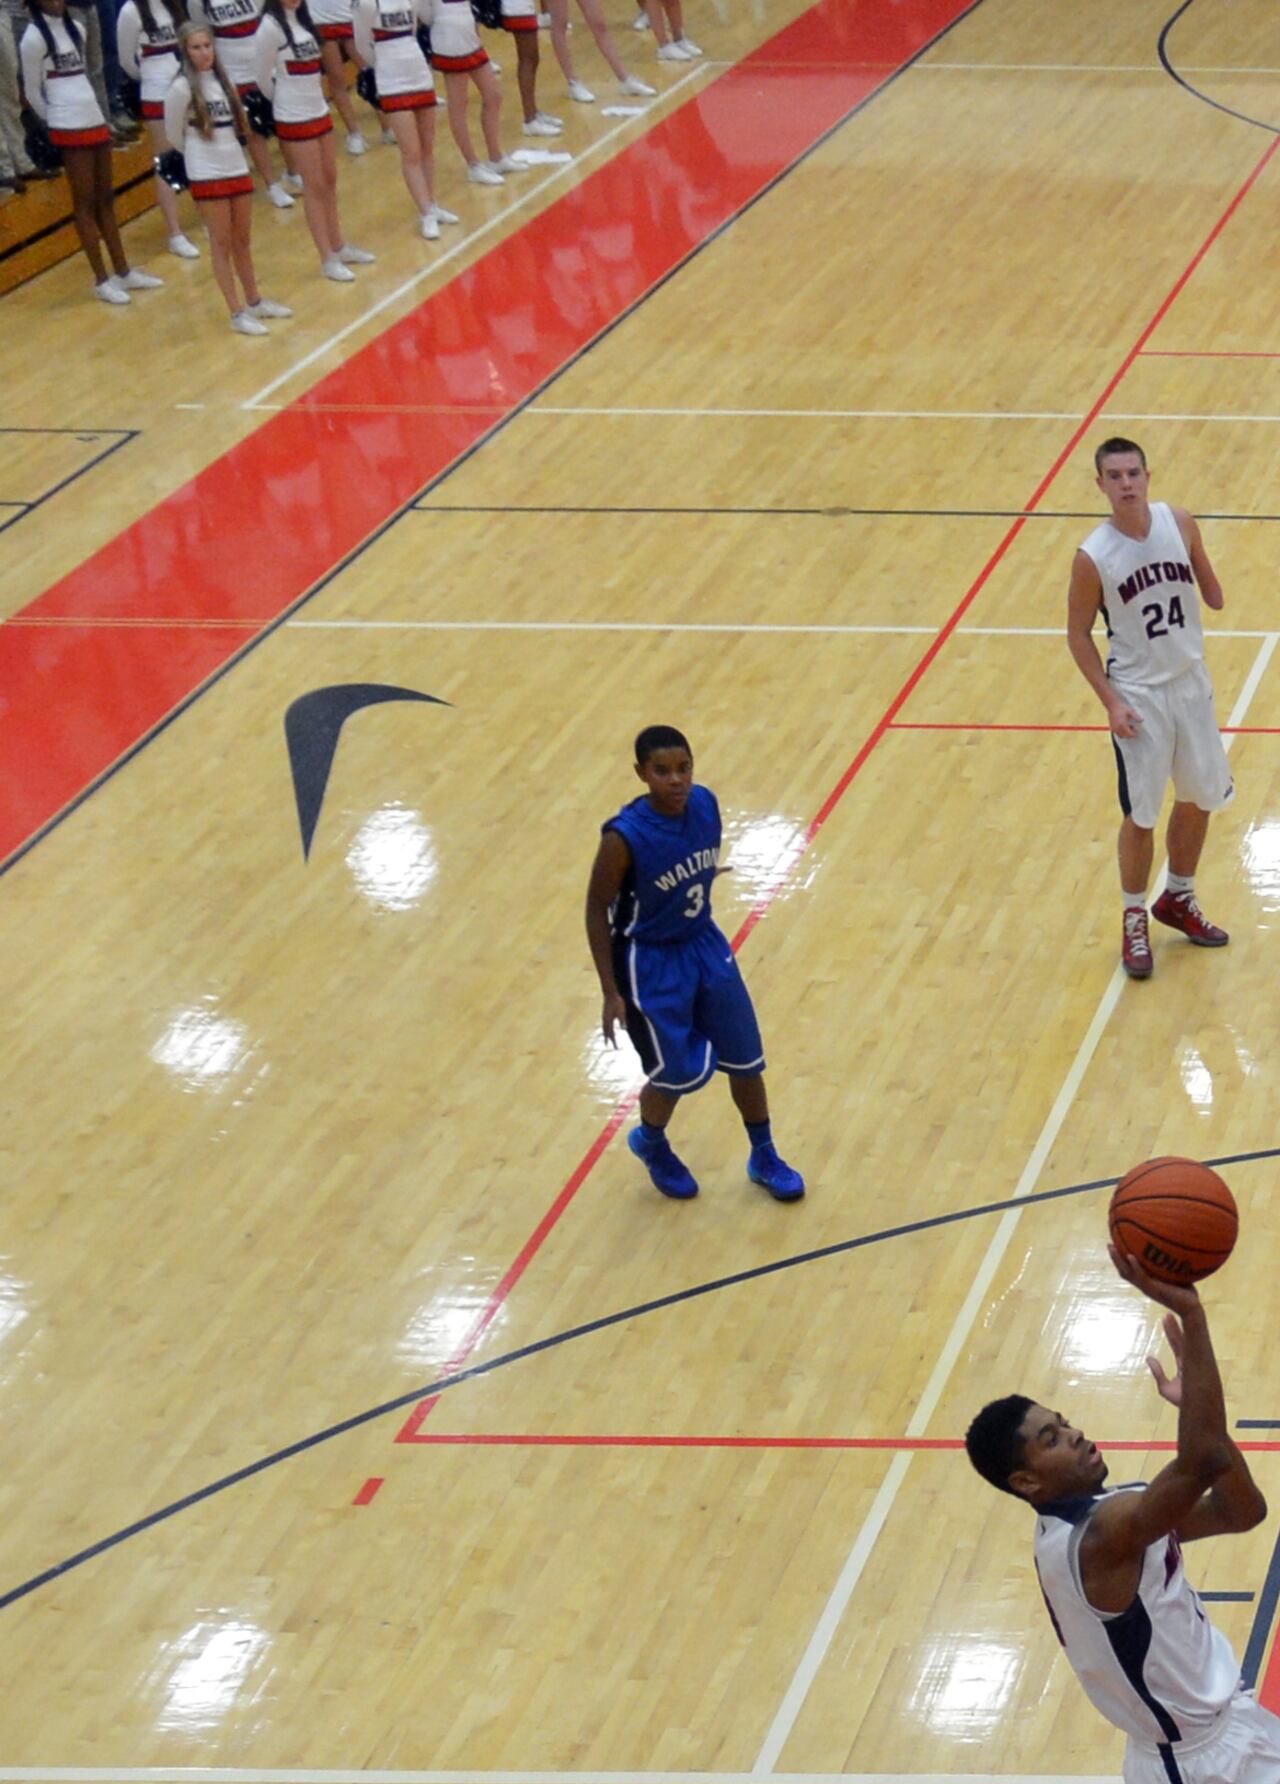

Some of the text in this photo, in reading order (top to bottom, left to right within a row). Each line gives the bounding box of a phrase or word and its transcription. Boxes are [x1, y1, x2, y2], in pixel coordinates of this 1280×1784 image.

[1117, 561, 1194, 605] MILTON
[1141, 595, 1185, 640] 24
[683, 883, 704, 918] 3
